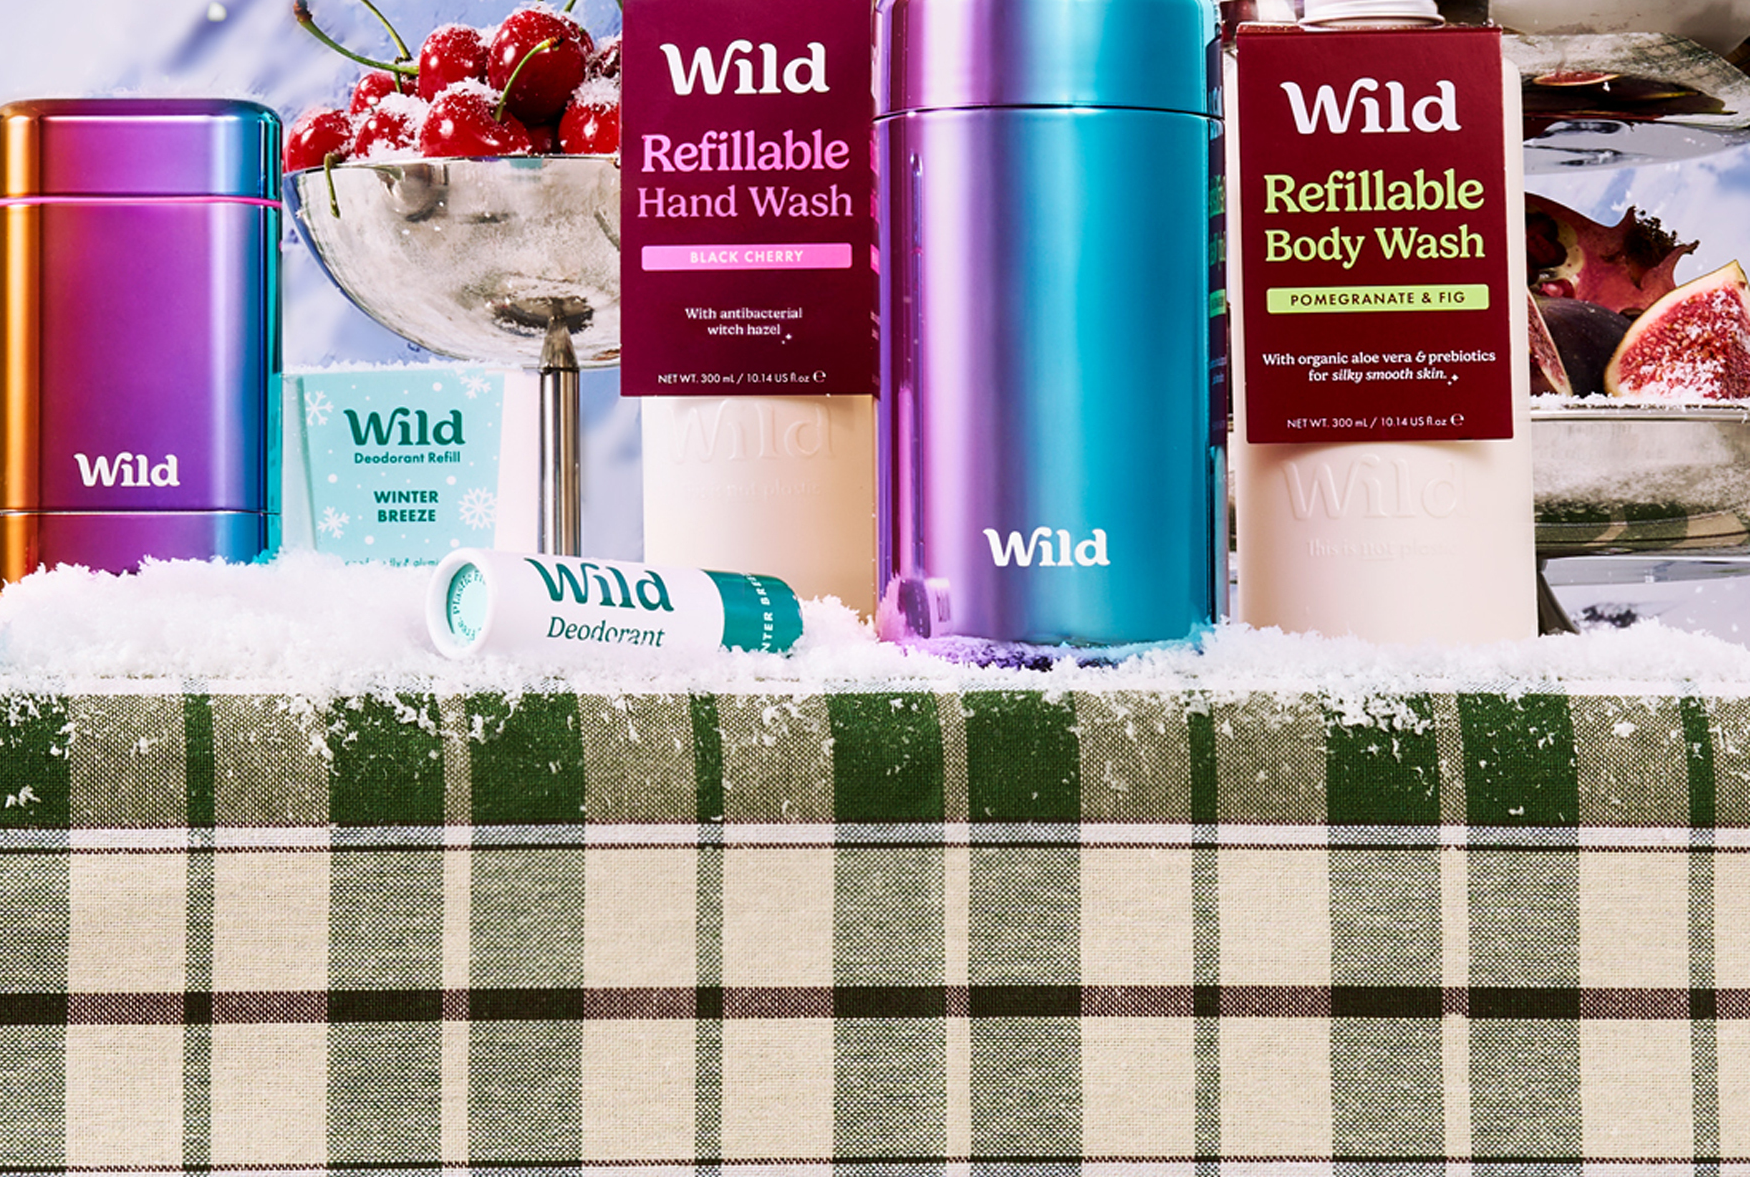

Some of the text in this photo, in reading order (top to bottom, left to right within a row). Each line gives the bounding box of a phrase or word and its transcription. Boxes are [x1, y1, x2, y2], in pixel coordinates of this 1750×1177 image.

[659, 39, 830, 95] Wild
[1280, 77, 1462, 134] Wild
[641, 128, 850, 172] Refillable
[637, 184, 738, 218] Hand
[748, 184, 854, 218] Wash
[1263, 168, 1485, 214] Refillable
[690, 250, 804, 264] BLACK CHERRY
[1264, 226, 1366, 270] Body
[1374, 224, 1486, 260] Wash
[685, 307, 803, 320] With antibacterial
[1291, 291, 1466, 306] POMEGRANATE & FIG
[707, 324, 781, 336] witch hazel
[1262, 350, 1496, 368] With organic aloe vera & prebiotics
[1308, 369, 1328, 382] for
[1332, 369, 1363, 384] silky
[1365, 368, 1413, 381] smooth
[658, 373, 678, 384] NET
[679, 373, 699, 384] WT.
[701, 373, 721, 383] 300
[736, 373, 744, 385] /
[747, 372, 772, 383] 10.14
[774, 372, 788, 383] US
[343, 407, 466, 446] Wild
[668, 398, 837, 464] Wild
[1287, 418, 1308, 429] NET
[1309, 418, 1330, 428] WT.
[1332, 417, 1353, 428] 300
[1369, 416, 1378, 429] /
[1381, 416, 1408, 427] 10.14
[1410, 416, 1425, 427] US
[74, 452, 180, 487] Wild
[354, 451, 461, 464] Deodorant Refill
[373, 490, 439, 504] WINTER
[1280, 453, 1470, 520] Wild
[377, 509, 437, 522] BREEZE
[983, 526, 1111, 567] Wild
[524, 557, 675, 612] Wild
[546, 616, 666, 648] Deodorant
[760, 612, 774, 653] NTER
